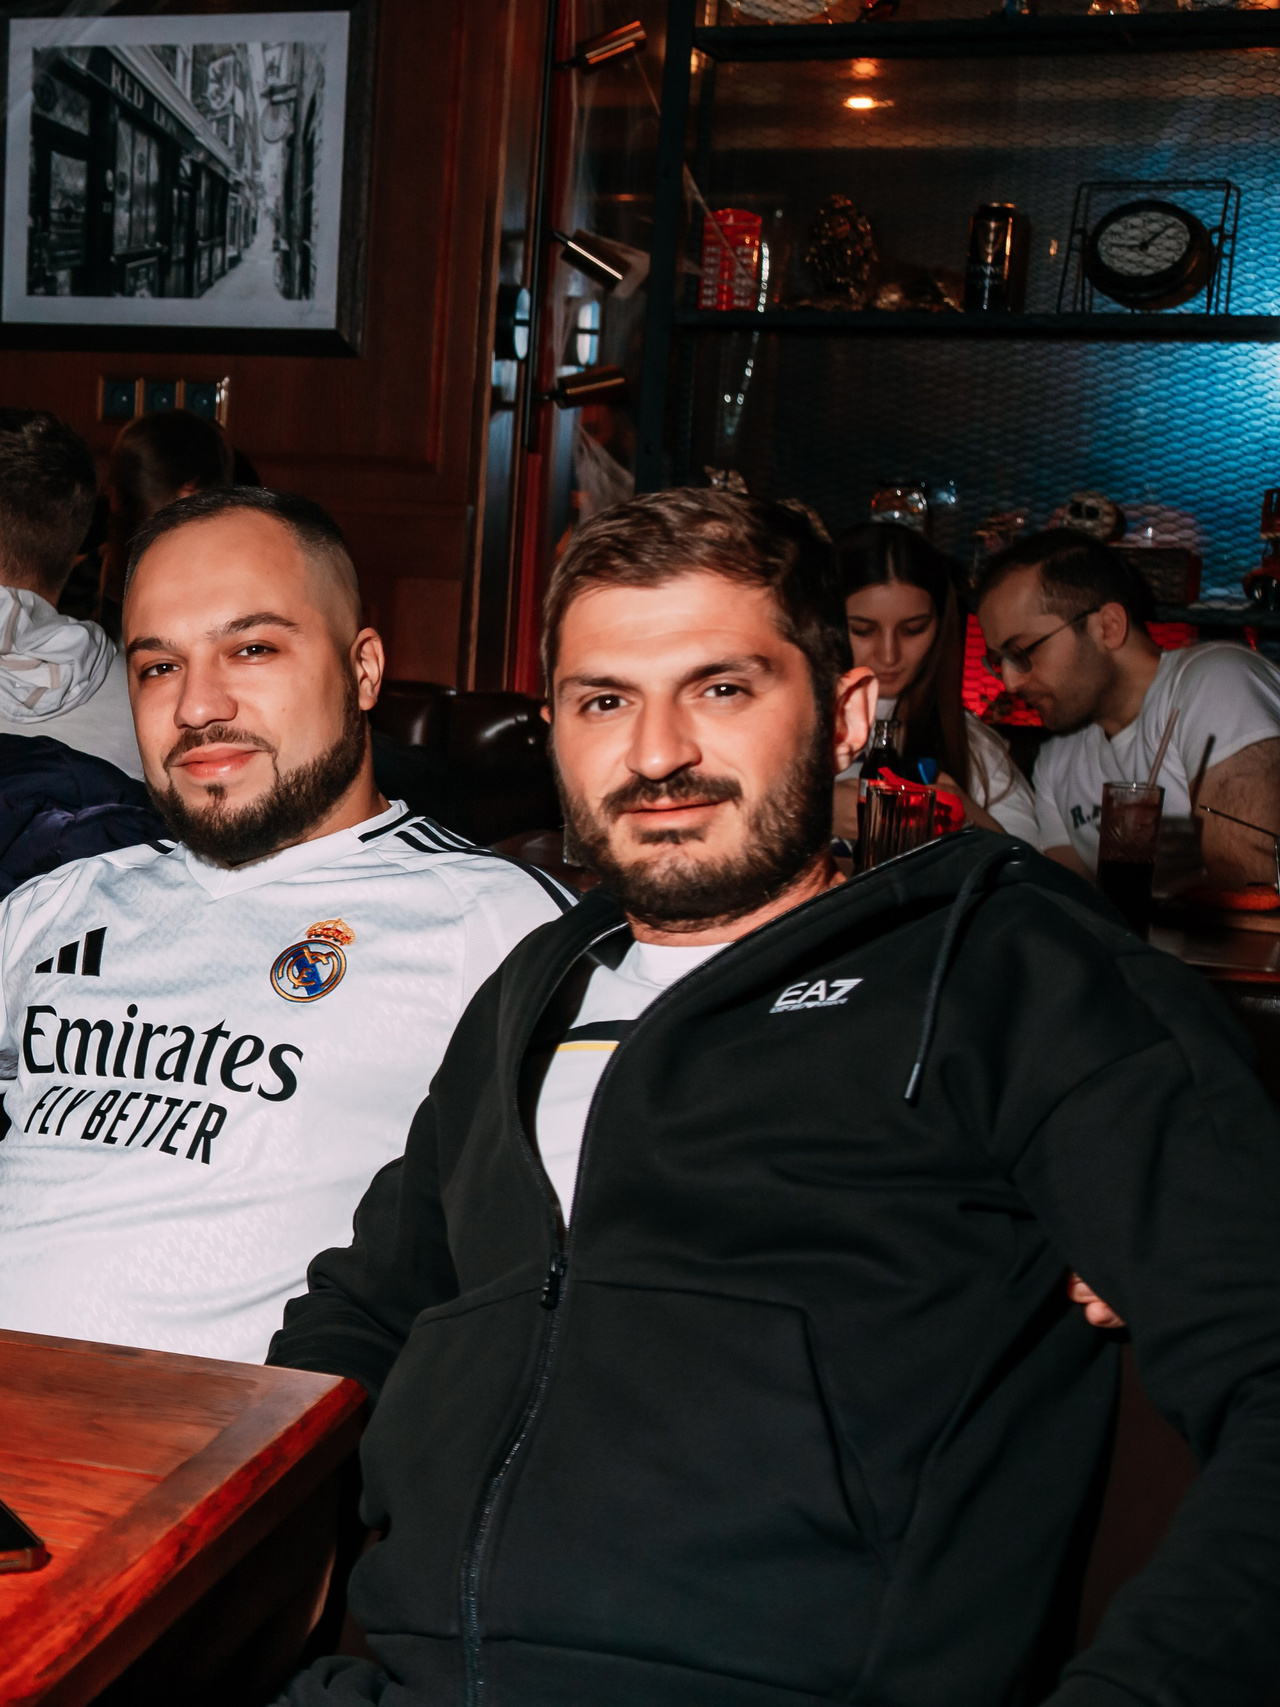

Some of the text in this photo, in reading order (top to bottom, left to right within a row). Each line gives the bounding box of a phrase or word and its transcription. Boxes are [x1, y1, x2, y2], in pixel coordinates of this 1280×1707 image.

[111, 61, 145, 110] RED
[774, 978, 863, 1007] EA7
[22, 1003, 305, 1102] Emirates
[23, 1085, 228, 1165] FLY BETTER
